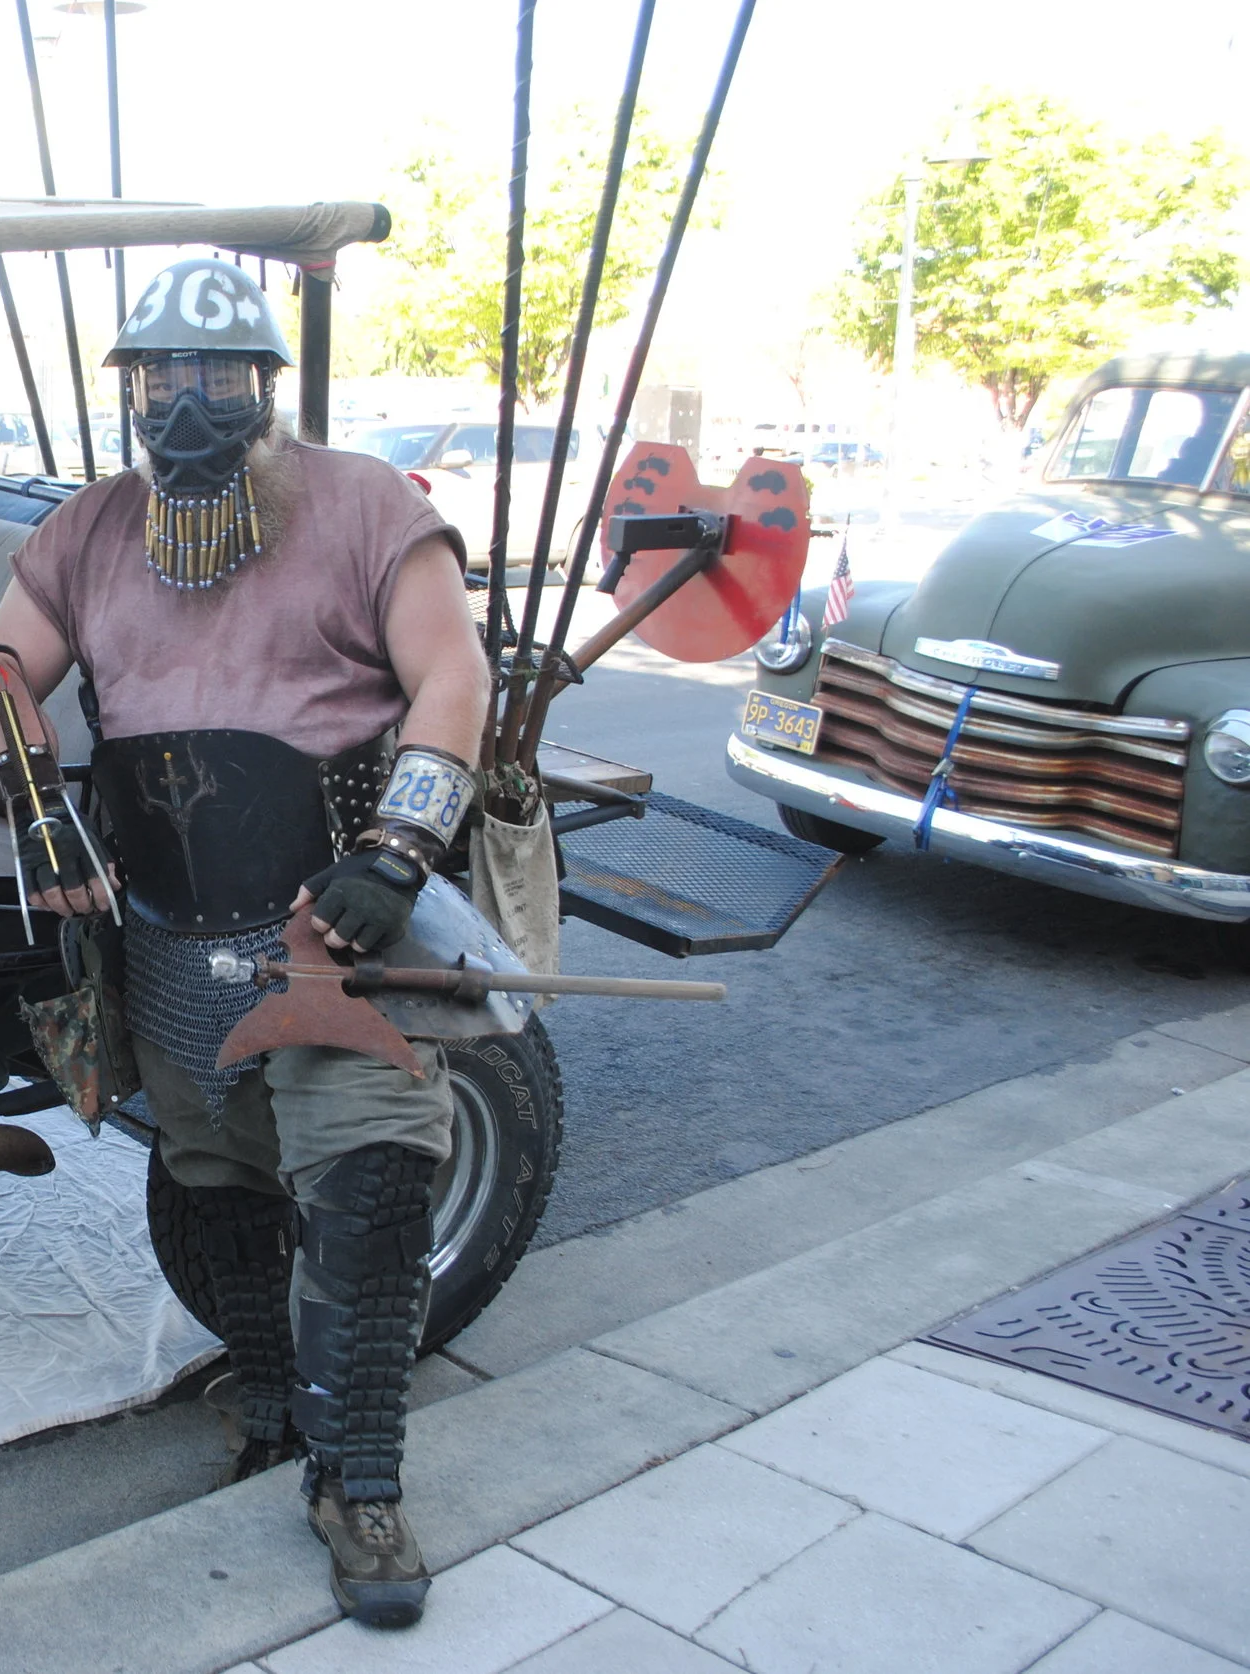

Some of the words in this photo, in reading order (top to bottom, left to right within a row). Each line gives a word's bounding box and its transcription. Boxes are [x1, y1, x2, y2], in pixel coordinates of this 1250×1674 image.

[127, 269, 236, 334] 36
[171, 350, 199, 359] SCOTT
[933, 648, 1029, 673] CHEVROLET
[747, 703, 815, 740] 9P-3643
